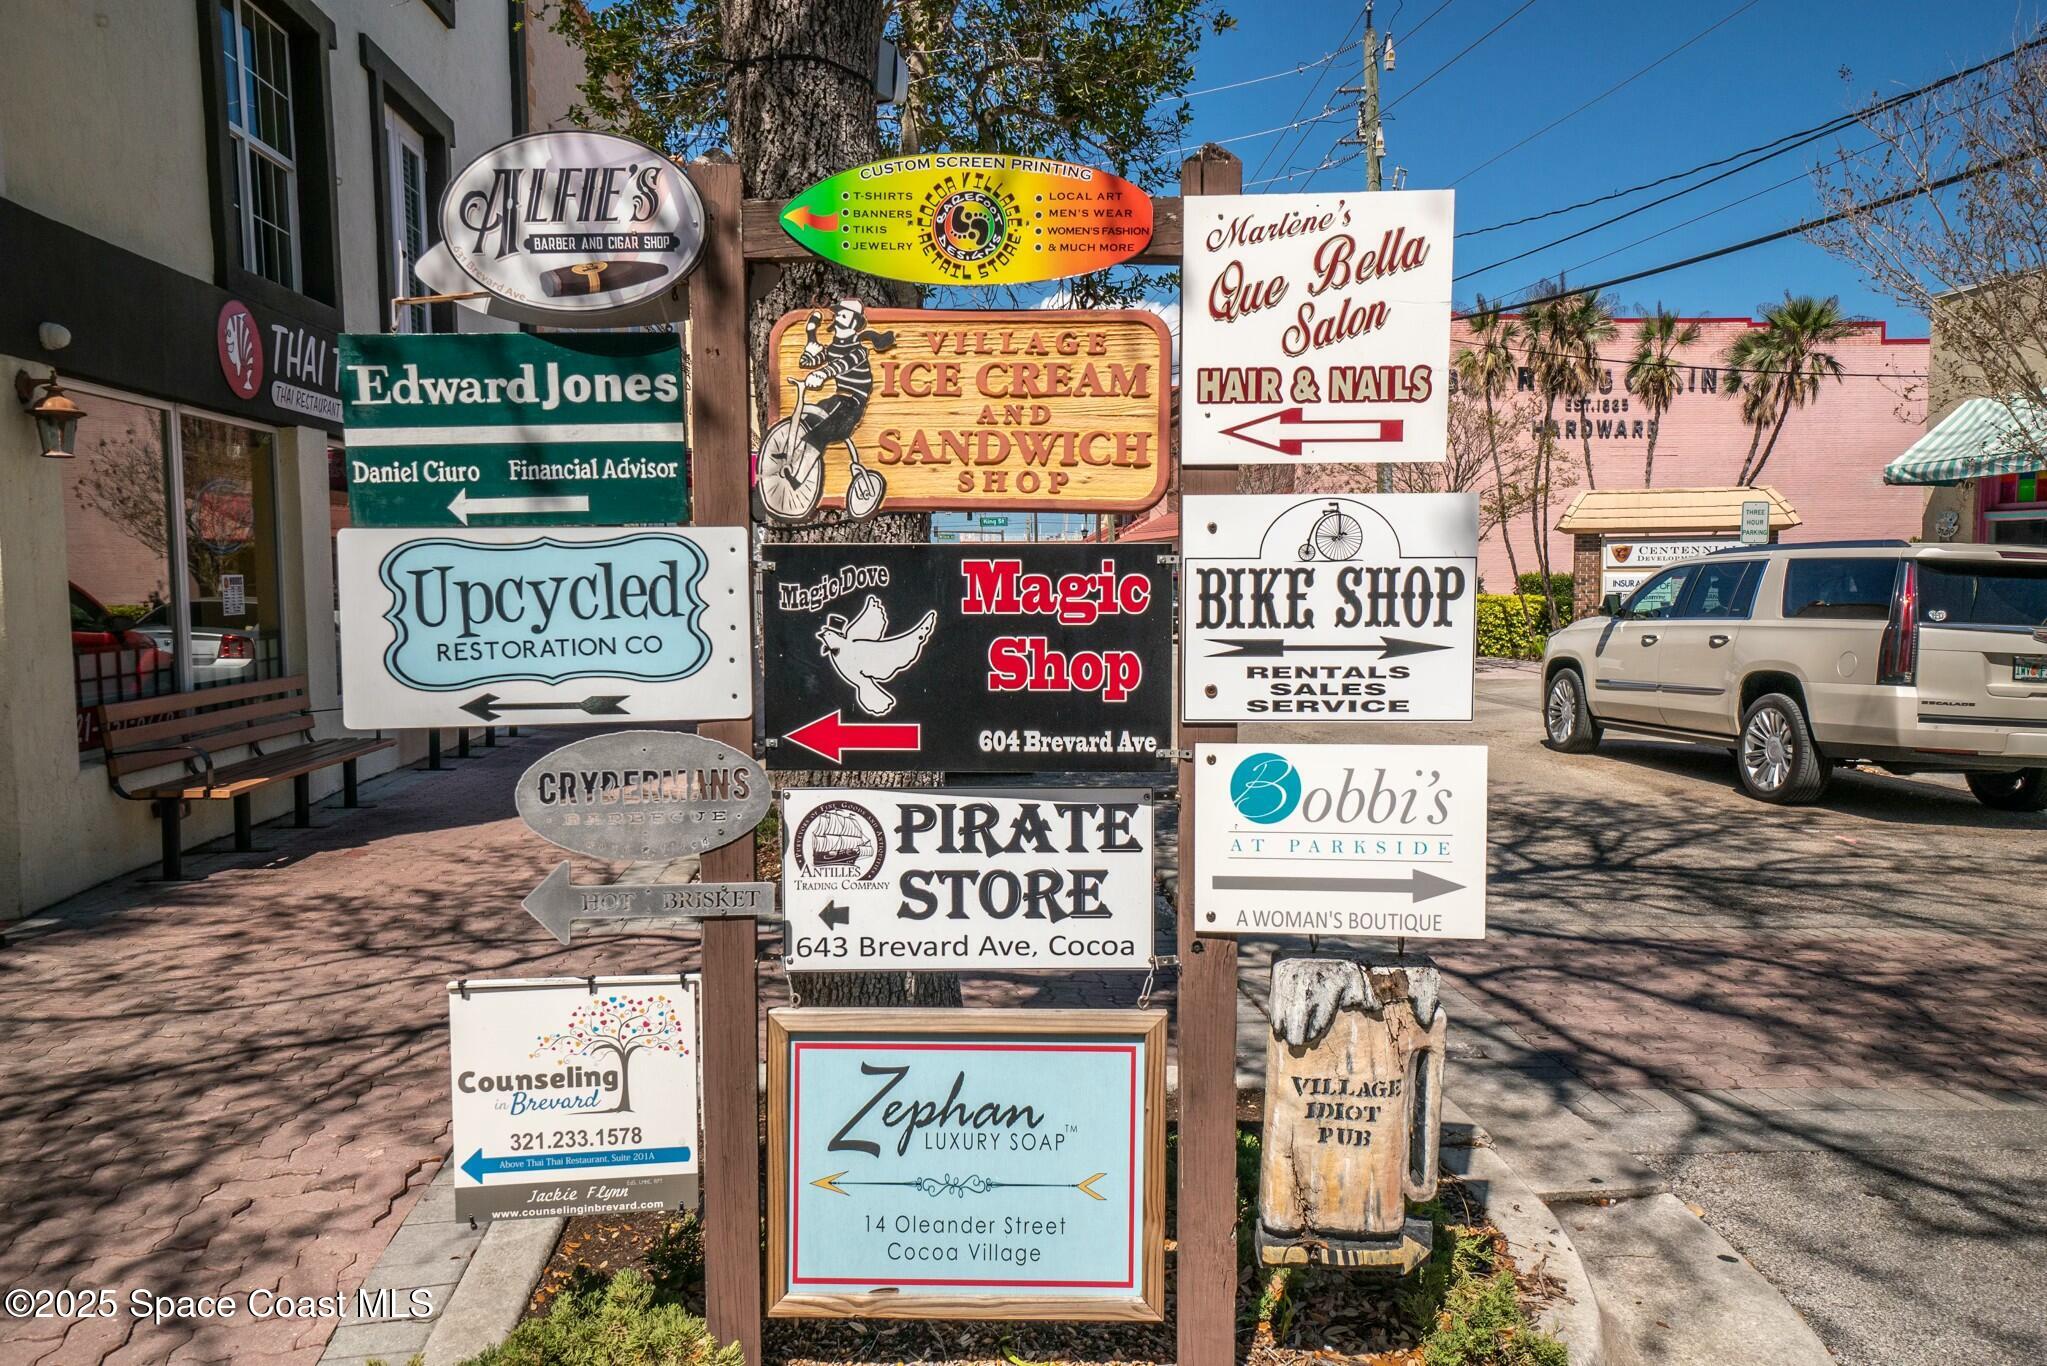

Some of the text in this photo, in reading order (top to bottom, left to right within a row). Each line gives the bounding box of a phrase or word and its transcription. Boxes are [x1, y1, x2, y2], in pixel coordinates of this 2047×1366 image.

[860, 155, 1093, 180] CUSTOM SCREEN PRINTING
[853, 191, 913, 201] T-SHIRTS
[962, 172, 1022, 227] VILLAGE
[1049, 192, 1123, 202] LOCAL ART
[459, 163, 663, 261] ALFIE'S
[853, 209, 913, 219] BANNERS
[1049, 208, 1133, 218] MEN'S WEAR
[853, 225, 887, 234] TIKIS
[1047, 226, 1150, 236] WOMEN'S FASHION
[534, 234, 670, 250] BARBER AND CIGAR SHOP
[852, 241, 913, 251] JEWELRY
[1048, 243, 1135, 252] & MUCH MORE
[978, 233, 1021, 278] STORE
[465, 261, 505, 292] Brevard
[1208, 226, 1431, 323] Que Bella
[1281, 297, 1391, 358] Salon
[925, 330, 1108, 356] VILLAGE
[271, 324, 326, 387] THAI
[880, 361, 1152, 399] ICE CREAM
[1197, 367, 1284, 404] HAIR
[1290, 366, 1322, 404] &
[1328, 364, 1433, 404] NAILS
[276, 385, 342, 418] THAI RESTAURANT
[976, 404, 1052, 426] AND
[877, 428, 1152, 468] SANDWICH
[352, 457, 678, 484] Daniel Ciuro Financial Advisor
[958, 470, 1070, 494] SHOP
[1637, 554, 1696, 562] DEVELOPM
[1639, 546, 1738, 555] CENTENNI
[406, 559, 685, 639] Upcycled
[778, 564, 890, 612] Magic Dove
[961, 559, 1151, 625] Magic
[1196, 565, 1466, 630] BIKE SHOP
[437, 635, 663, 662] RESTORATION CO
[987, 637, 1142, 702] Shop
[1246, 666, 1410, 679] RENTALS
[1270, 683, 1386, 696] SALES
[1246, 700, 1410, 713] SERVICE
[978, 730, 1157, 753] 604 Brevard Ave
[537, 767, 751, 806] CRYDERMANS
[1232, 758, 1453, 825] Bobbi's
[561, 811, 728, 826] BARBECUE
[894, 802, 1144, 858] PIRATE
[1230, 839, 1451, 856] AT PARKSIDE
[800, 864, 861, 878] ANTILLES
[794, 880, 890, 890] TRADING COMPANY
[897, 867, 1113, 923] STORE
[581, 893, 636, 912] HOT
[663, 889, 760, 909] BRISKET
[1236, 910, 1442, 933] A WOMAN'S BOUTIQUE
[796, 935, 1135, 959] 643 Brevard Ave, Cocoa
[457, 1066, 618, 1094] Counseling
[1290, 1075, 1402, 1097] VILLAGE
[495, 1089, 602, 1116] in Brevard
[827, 1060, 1045, 1159] Zephan
[1304, 1102, 1381, 1123] IDIOT
[510, 1127, 643, 1151] 321.233.1578
[925, 1132, 1001, 1150] LUXURY
[1009, 1133, 1066, 1151] SOAP
[1317, 1126, 1371, 1147] PUB
[499, 1160, 525, 1169] Above
[526, 1158, 544, 1167] Thai
[546, 1157, 564, 1166] Thai
[611, 1153, 631, 1162] Suite
[633, 1152, 656, 1161] 201A
[527, 1185, 629, 1203] Jackie Flynn
[492, 1201, 664, 1219] www.counselinginbrevard.com
[865, 1215, 1066, 1235] 14 Oleander Street
[887, 1242, 1041, 1266] Cocoa Village
